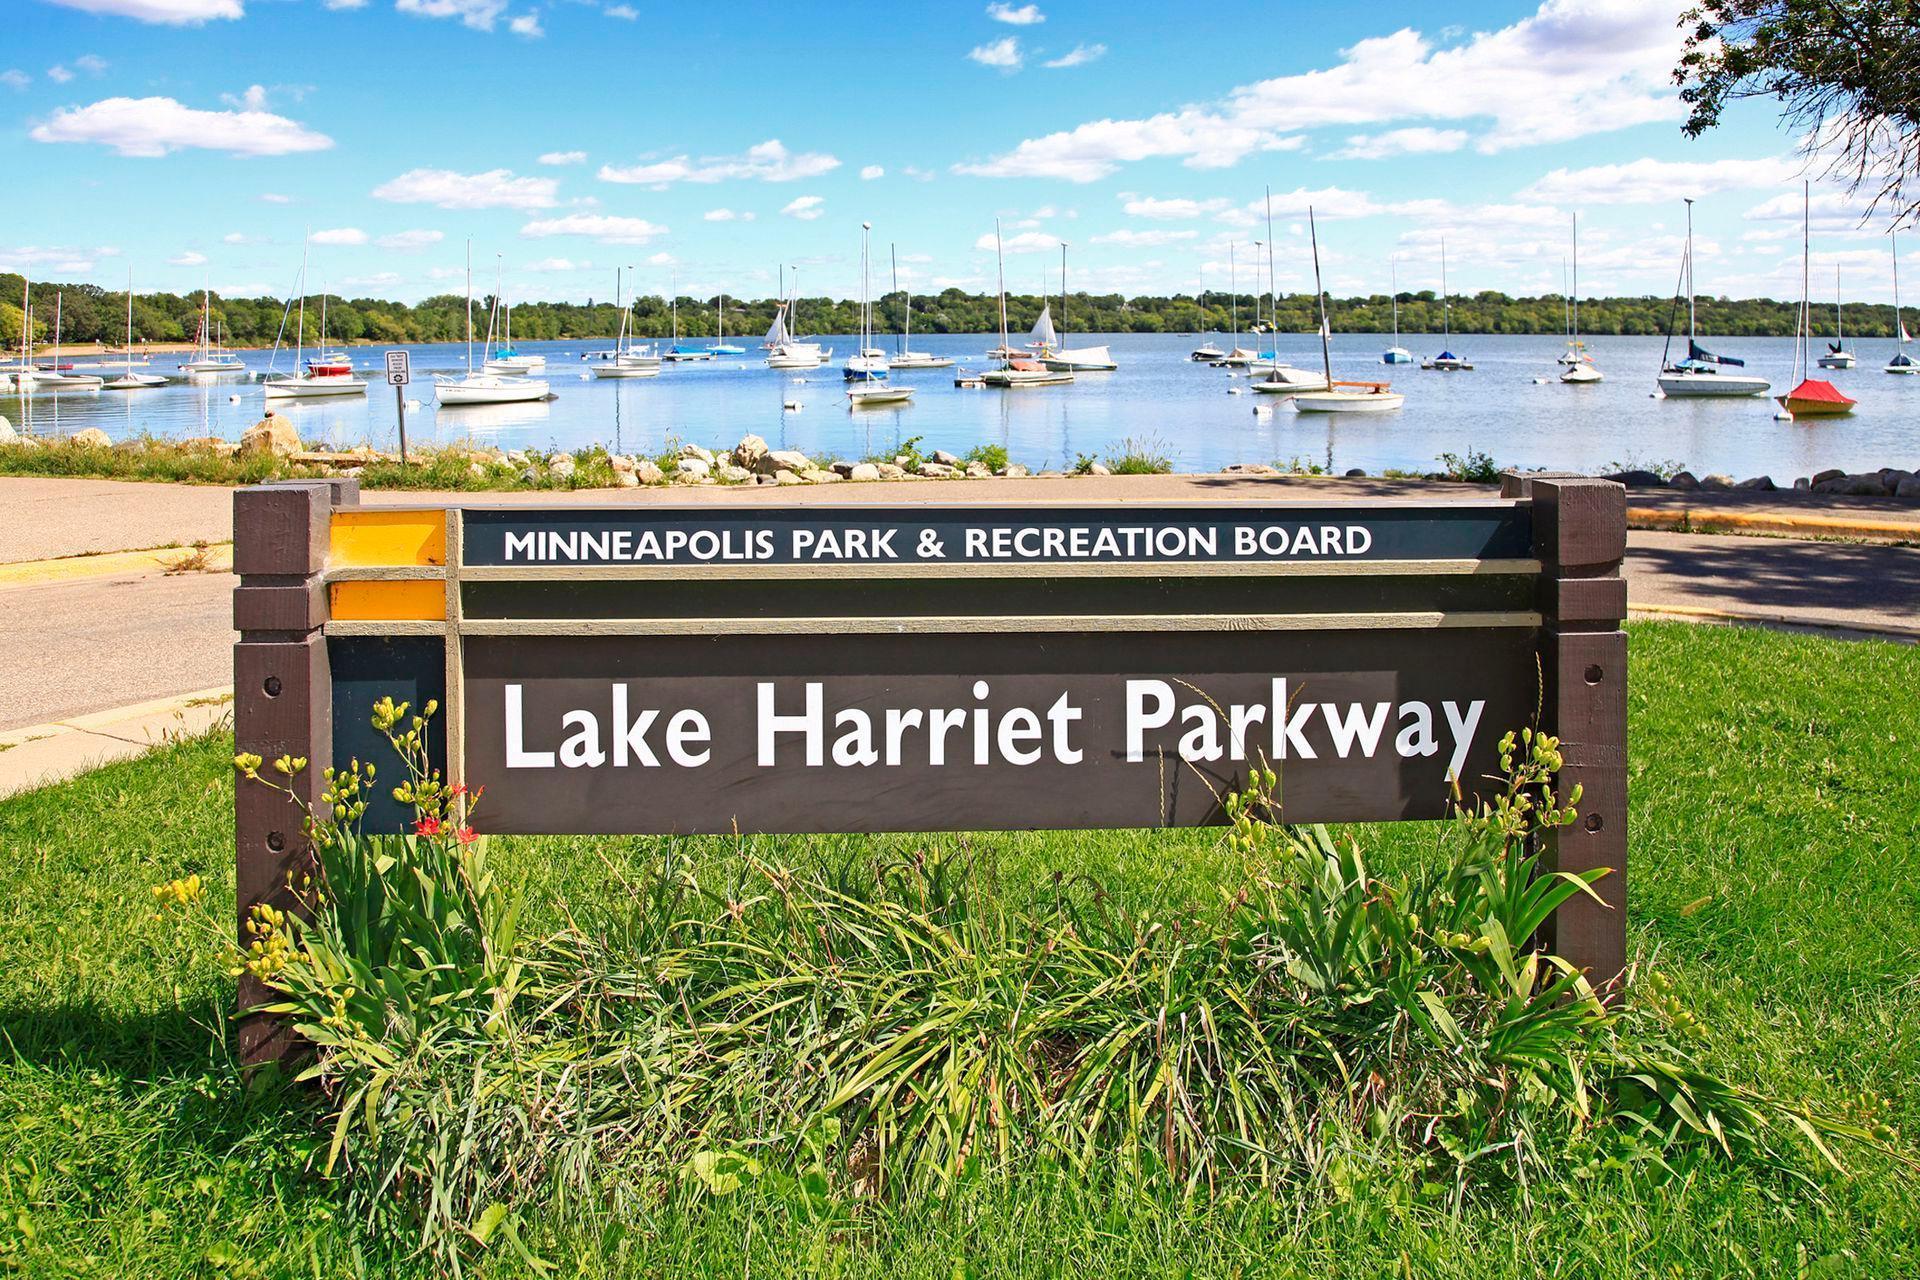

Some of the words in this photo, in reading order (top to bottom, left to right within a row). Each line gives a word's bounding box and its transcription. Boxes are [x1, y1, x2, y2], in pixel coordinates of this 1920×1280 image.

[504, 530, 775, 561] MINNEAPOLIS
[792, 527, 899, 559] PARK
[916, 528, 947, 558] &
[965, 526, 1217, 558] RECREATION
[1234, 525, 1372, 556] BOARD
[504, 683, 711, 769] Lake
[756, 680, 1084, 767] Harriet
[1125, 677, 1486, 782] Parkway
